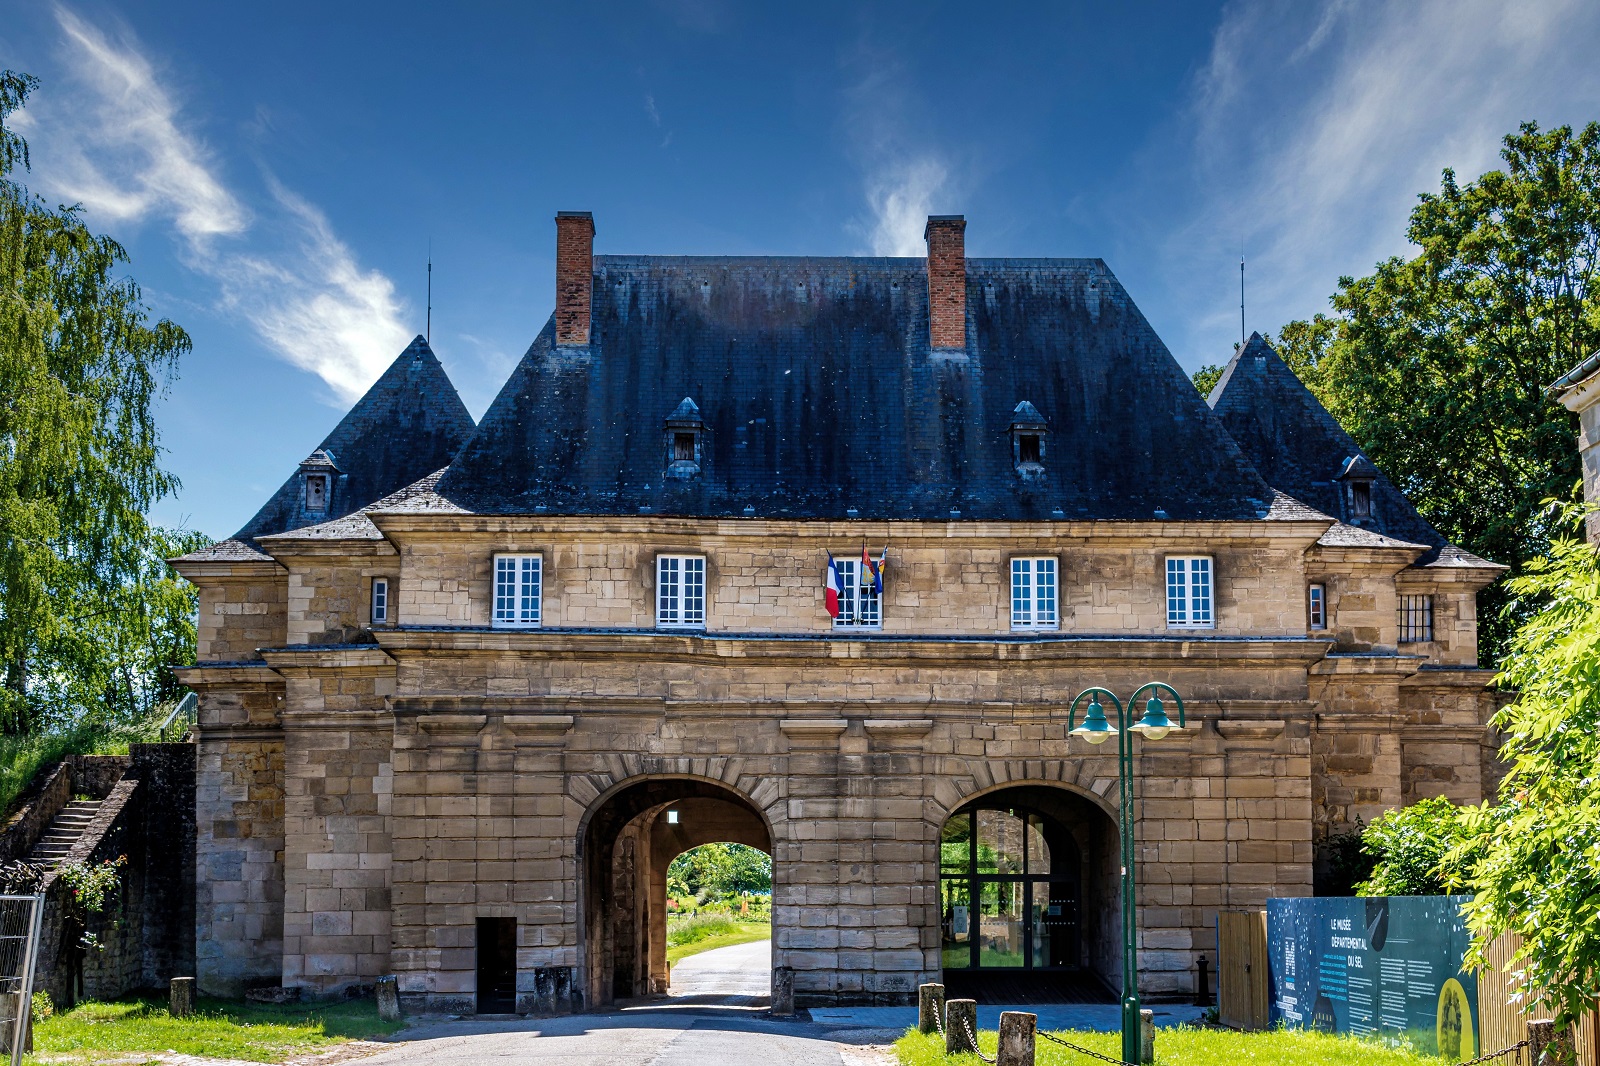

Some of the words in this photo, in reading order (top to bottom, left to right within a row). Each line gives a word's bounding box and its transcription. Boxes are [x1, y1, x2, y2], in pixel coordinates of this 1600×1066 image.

[1330, 918, 1336, 930] LE
[1337, 916, 1351, 931] MUSÉE
[1331, 934, 1368, 951] DÉPARTEMENTAL
[1354, 955, 1364, 969] SEL
